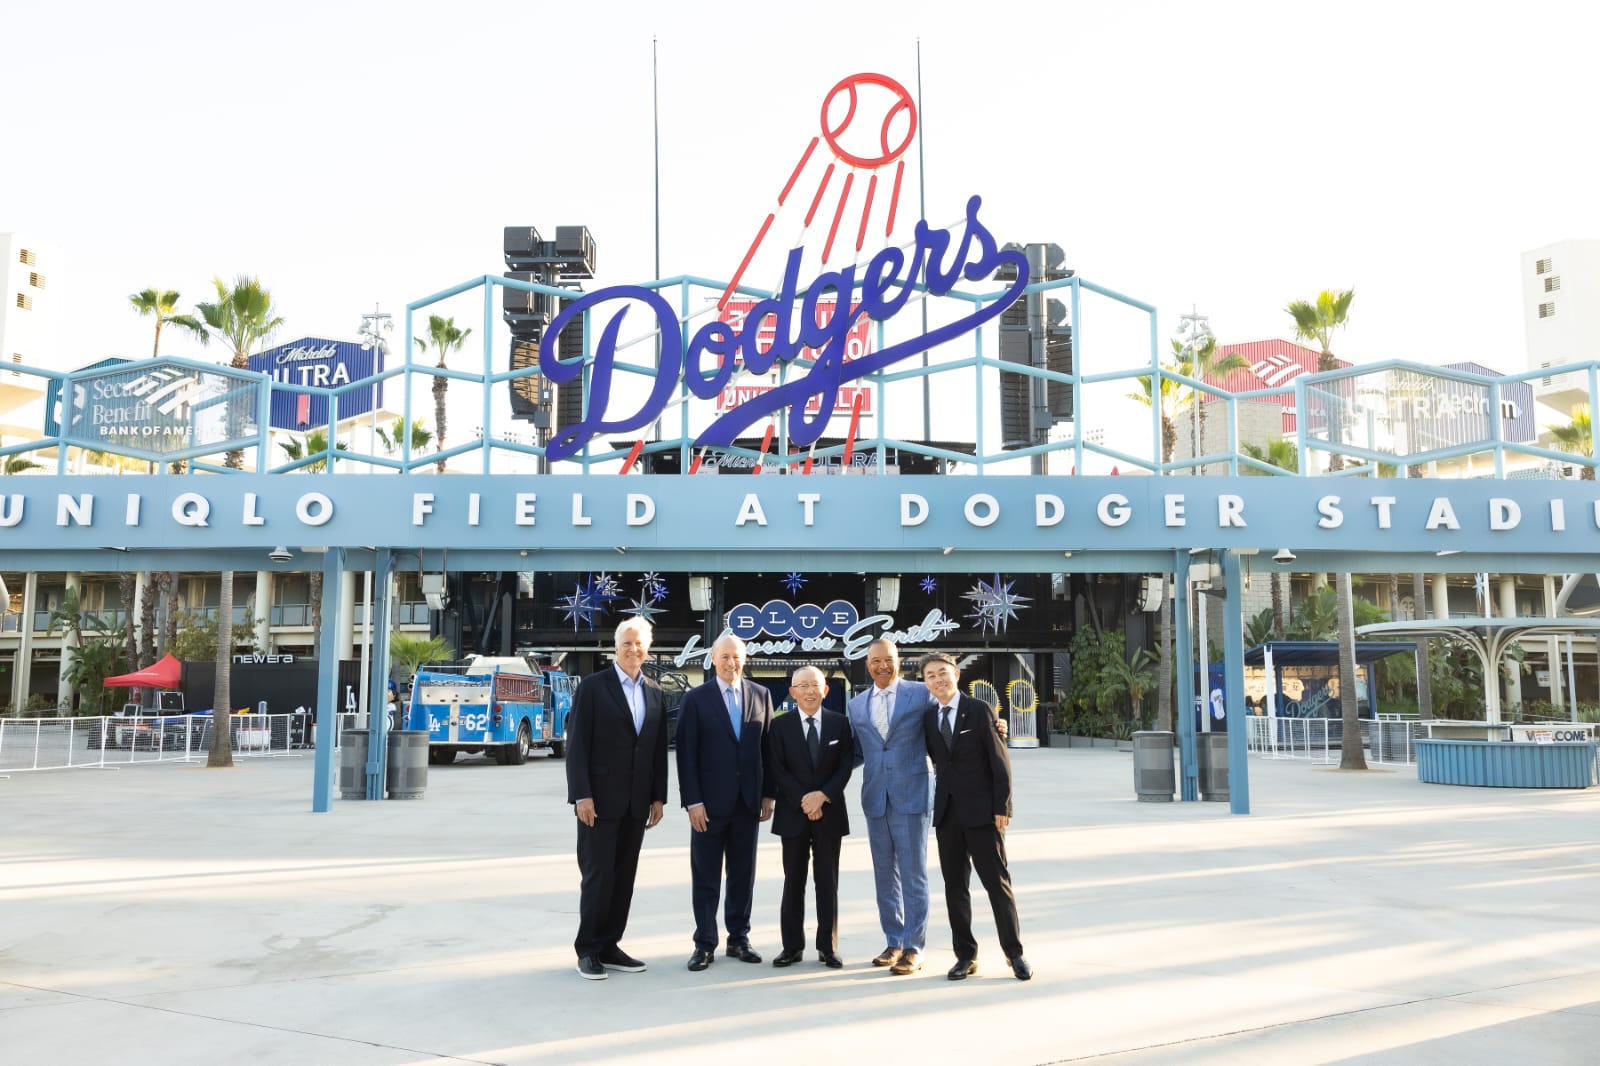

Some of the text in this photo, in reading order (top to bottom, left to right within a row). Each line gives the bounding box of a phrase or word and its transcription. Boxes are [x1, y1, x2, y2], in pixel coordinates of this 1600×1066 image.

[539, 195, 1030, 461] Dodgers
[276, 344, 337, 364] Michelob
[100, 426, 139, 435] BANK
[142, 426, 160, 435] OF
[799, 452, 878, 468] ULRA
[0, 493, 1600, 531] UNIQLO FIELD AT DODGER STADI
[738, 611, 849, 629] BLUE
[673, 628, 796, 669] Hven
[801, 635, 837, 652] on
[428, 713, 441, 732] LA
[466, 713, 487, 731] 62
[1525, 730, 1586, 742] WCOME
